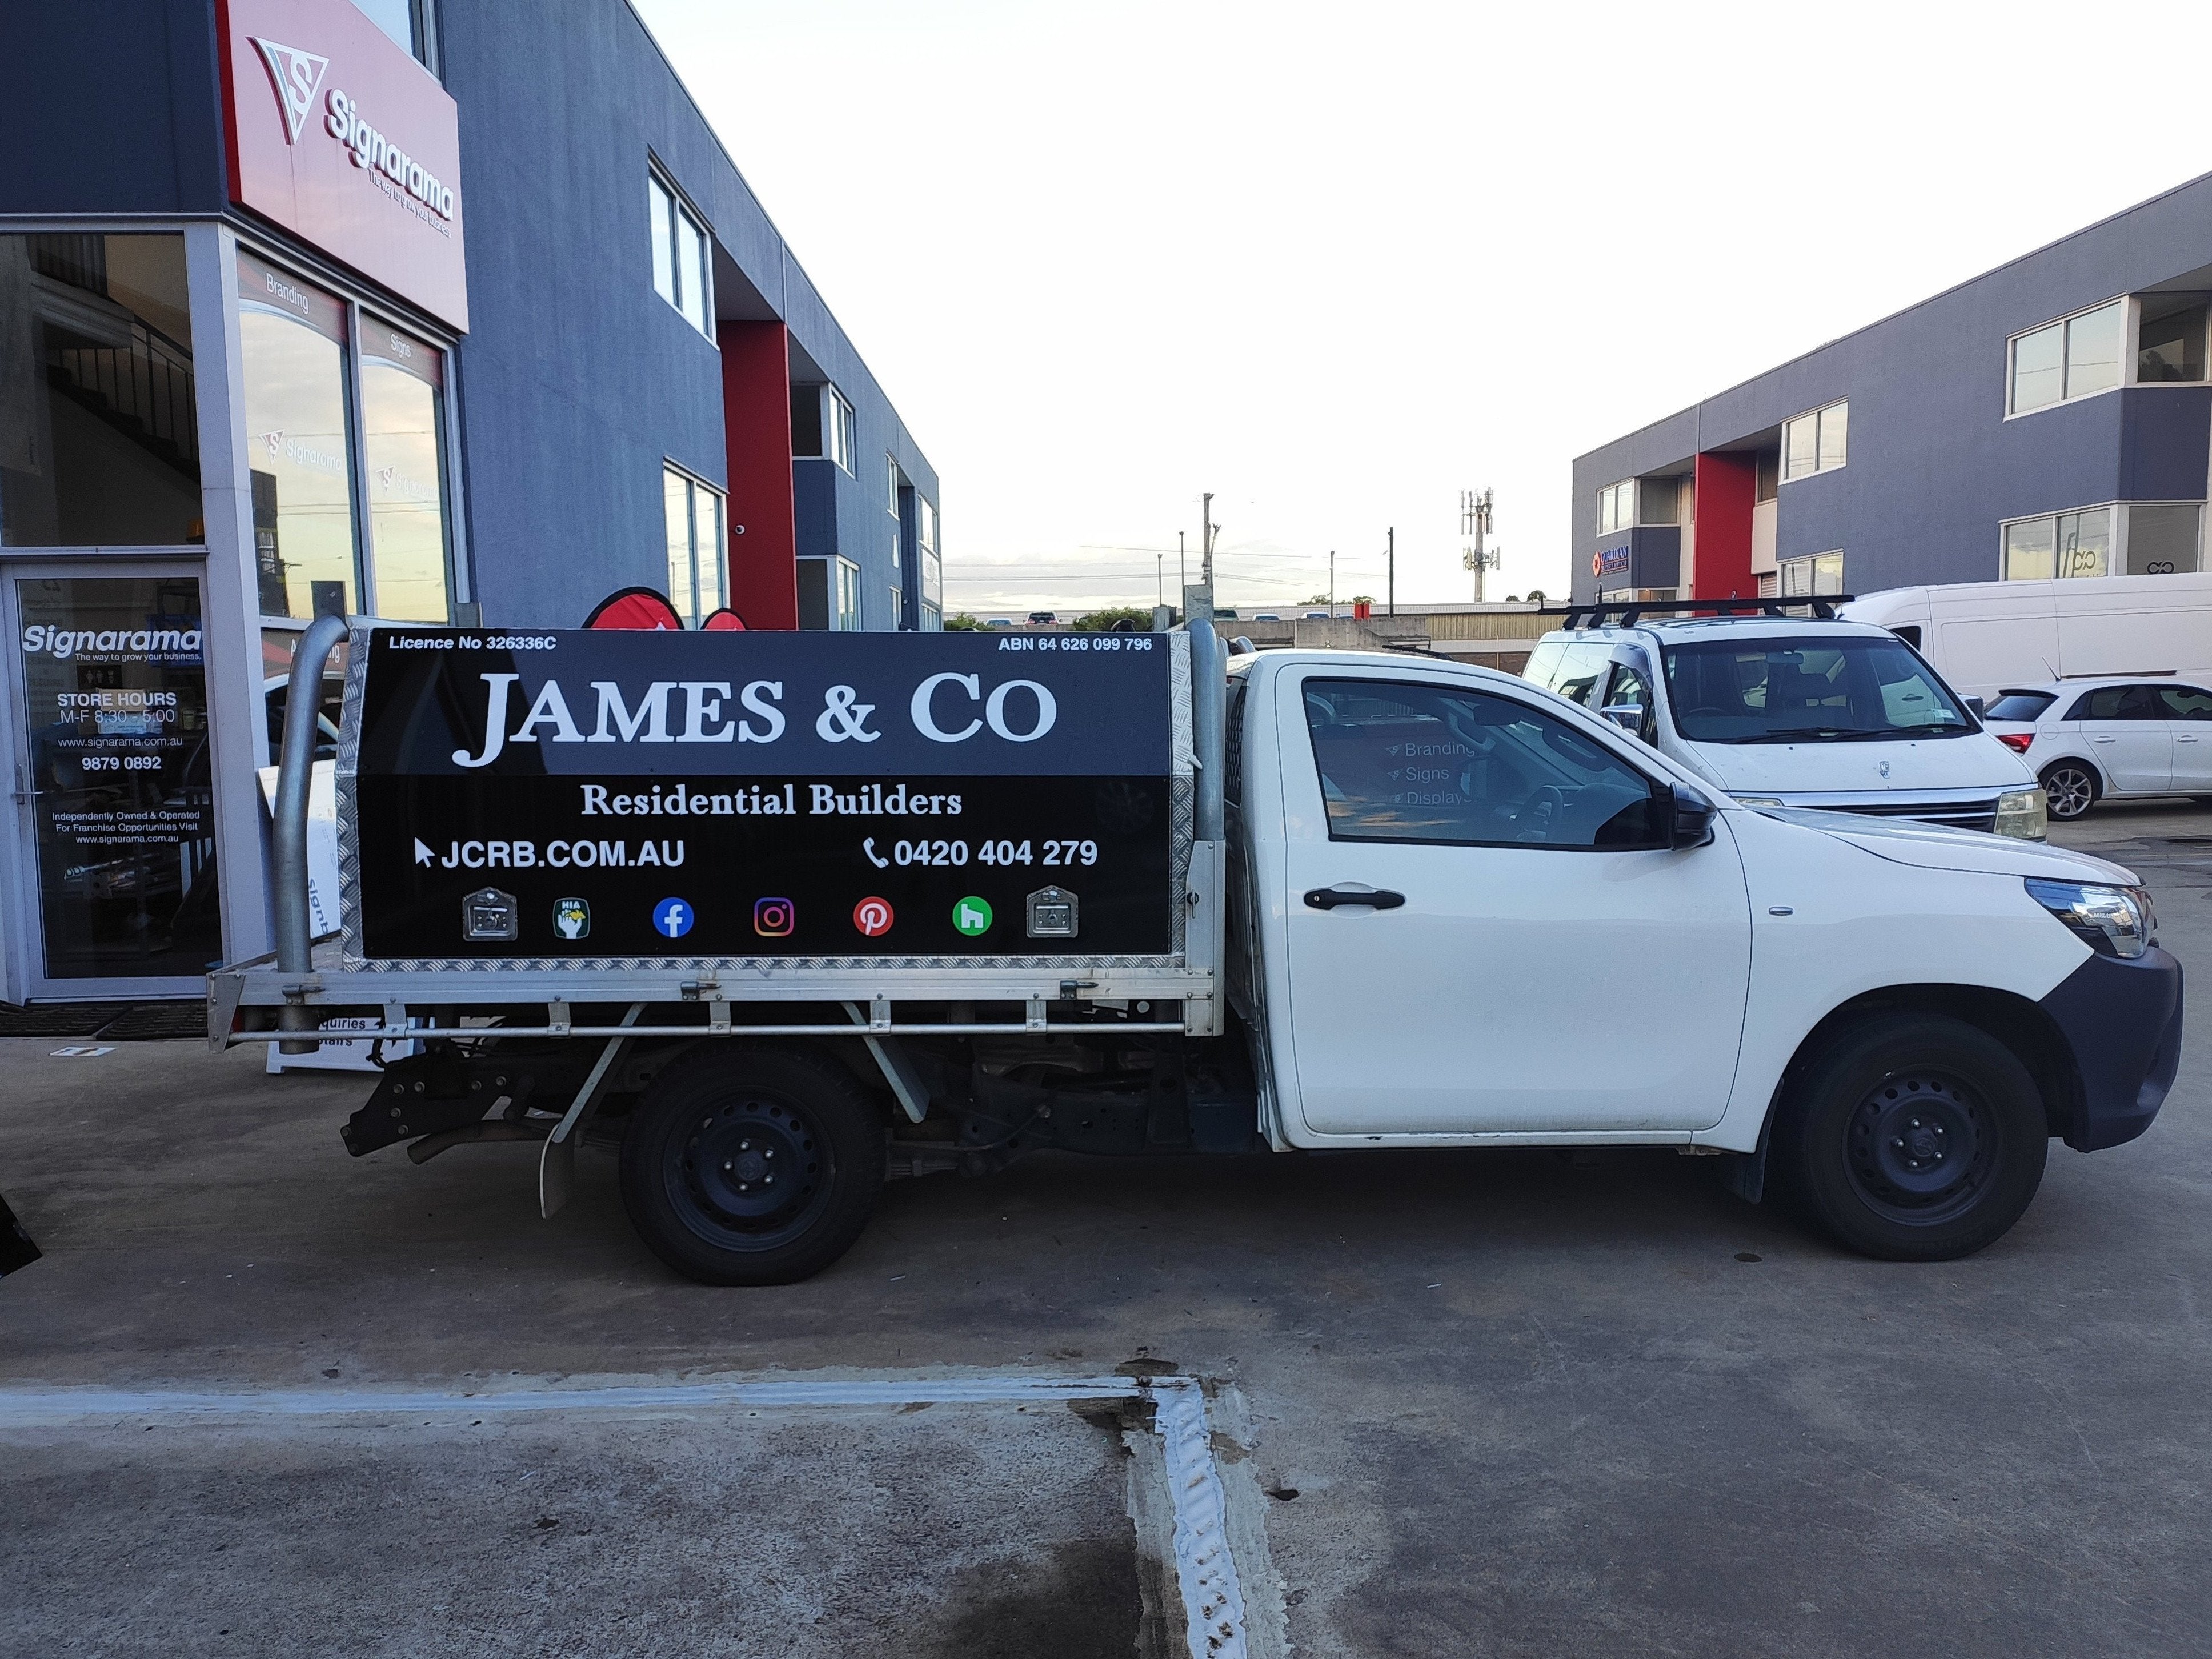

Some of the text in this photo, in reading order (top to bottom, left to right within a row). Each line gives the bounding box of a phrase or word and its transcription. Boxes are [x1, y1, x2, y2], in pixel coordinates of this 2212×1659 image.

[324, 89, 454, 222] Signarama
[368, 168, 382, 188] The
[266, 273, 309, 314] Branding
[391, 334, 411, 358] Signs
[285, 438, 342, 472] Signarama
[22, 624, 202, 658] Signarama
[389, 636, 557, 650] Licence No 326336C
[999, 638, 1152, 650] ABN 64 626 099 796
[92, 654, 109, 663] way
[121, 654, 142, 663] grow
[57, 692, 177, 707] STORE HOURS
[61, 710, 89, 723] M-F
[94, 710, 127, 723] 8:30
[142, 709, 175, 723] 5:00
[452, 672, 786, 767] JAMES
[815, 685, 881, 743] &
[58, 737, 183, 748] www.signarama.com.au
[82, 756, 162, 770] 9879 0892
[1406, 767, 1449, 783] Signs
[580, 783, 963, 816] Residential Builders
[1407, 791, 1472, 806] Display
[52, 812, 114, 822] Independently
[116, 811, 147, 820] Owned
[159, 810, 200, 821] Operated
[56, 822, 198, 833] For Franchise Opportunities Visit
[76, 835, 179, 845] www.signarama.com.au
[441, 840, 685, 868] JCRB.COM.AU
[893, 840, 1098, 867] 0420 404 279
[562, 901, 581, 909] HIA
[322, 1018, 366, 1031] quiries
